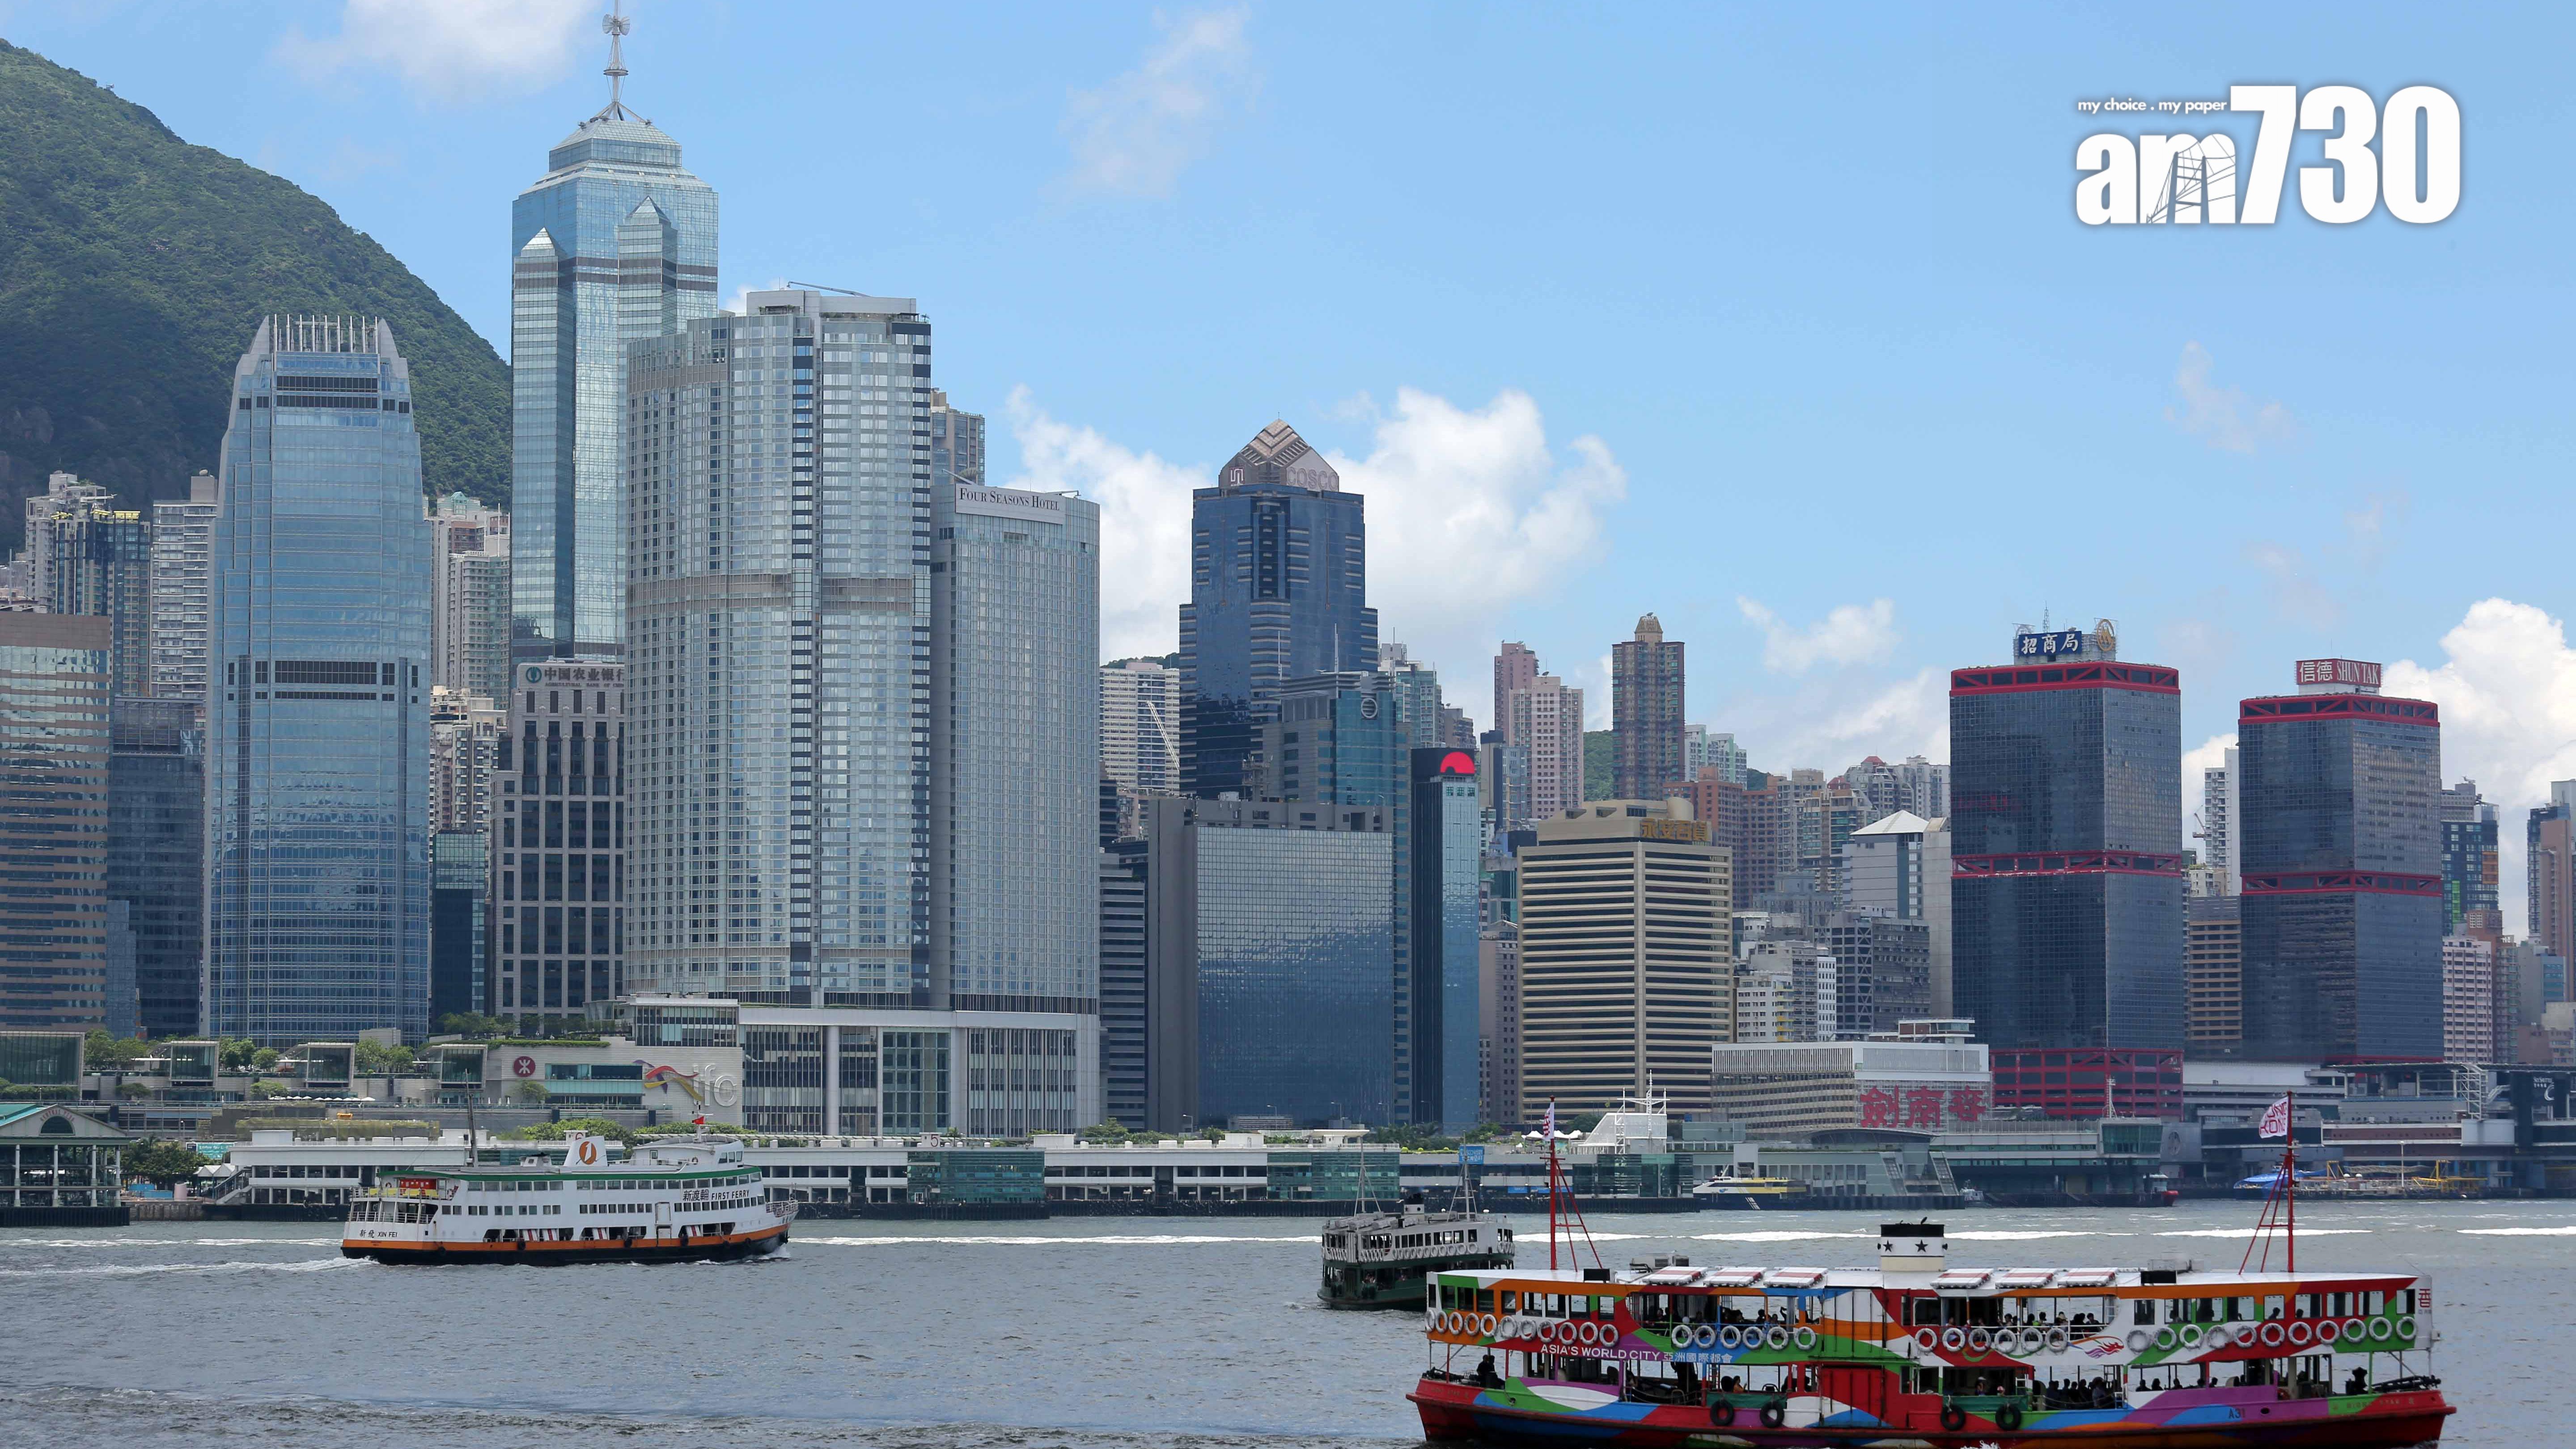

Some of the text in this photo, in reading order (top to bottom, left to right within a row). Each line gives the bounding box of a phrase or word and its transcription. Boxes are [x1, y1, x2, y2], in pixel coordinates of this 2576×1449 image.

[1287, 466, 1338, 490] COSCO
[959, 487, 1059, 511] FOUR SEASONS HOTEL
[2021, 633, 2078, 654] 招商局
[2300, 661, 2333, 682] 信德
[2337, 661, 2379, 684] SHUN TAK
[1860, 1085, 1986, 1128] 劍南春
[931, 1134, 938, 1147] 5
[683, 1189, 709, 1201] 新渡輪
[711, 1189, 750, 1200] FIRST FERRY
[2419, 1288, 2432, 1308] 香
[1540, 1344, 1661, 1360] ASIA'S WORLD CITY
[1663, 1352, 1732, 1364] 亞洲國際都會
